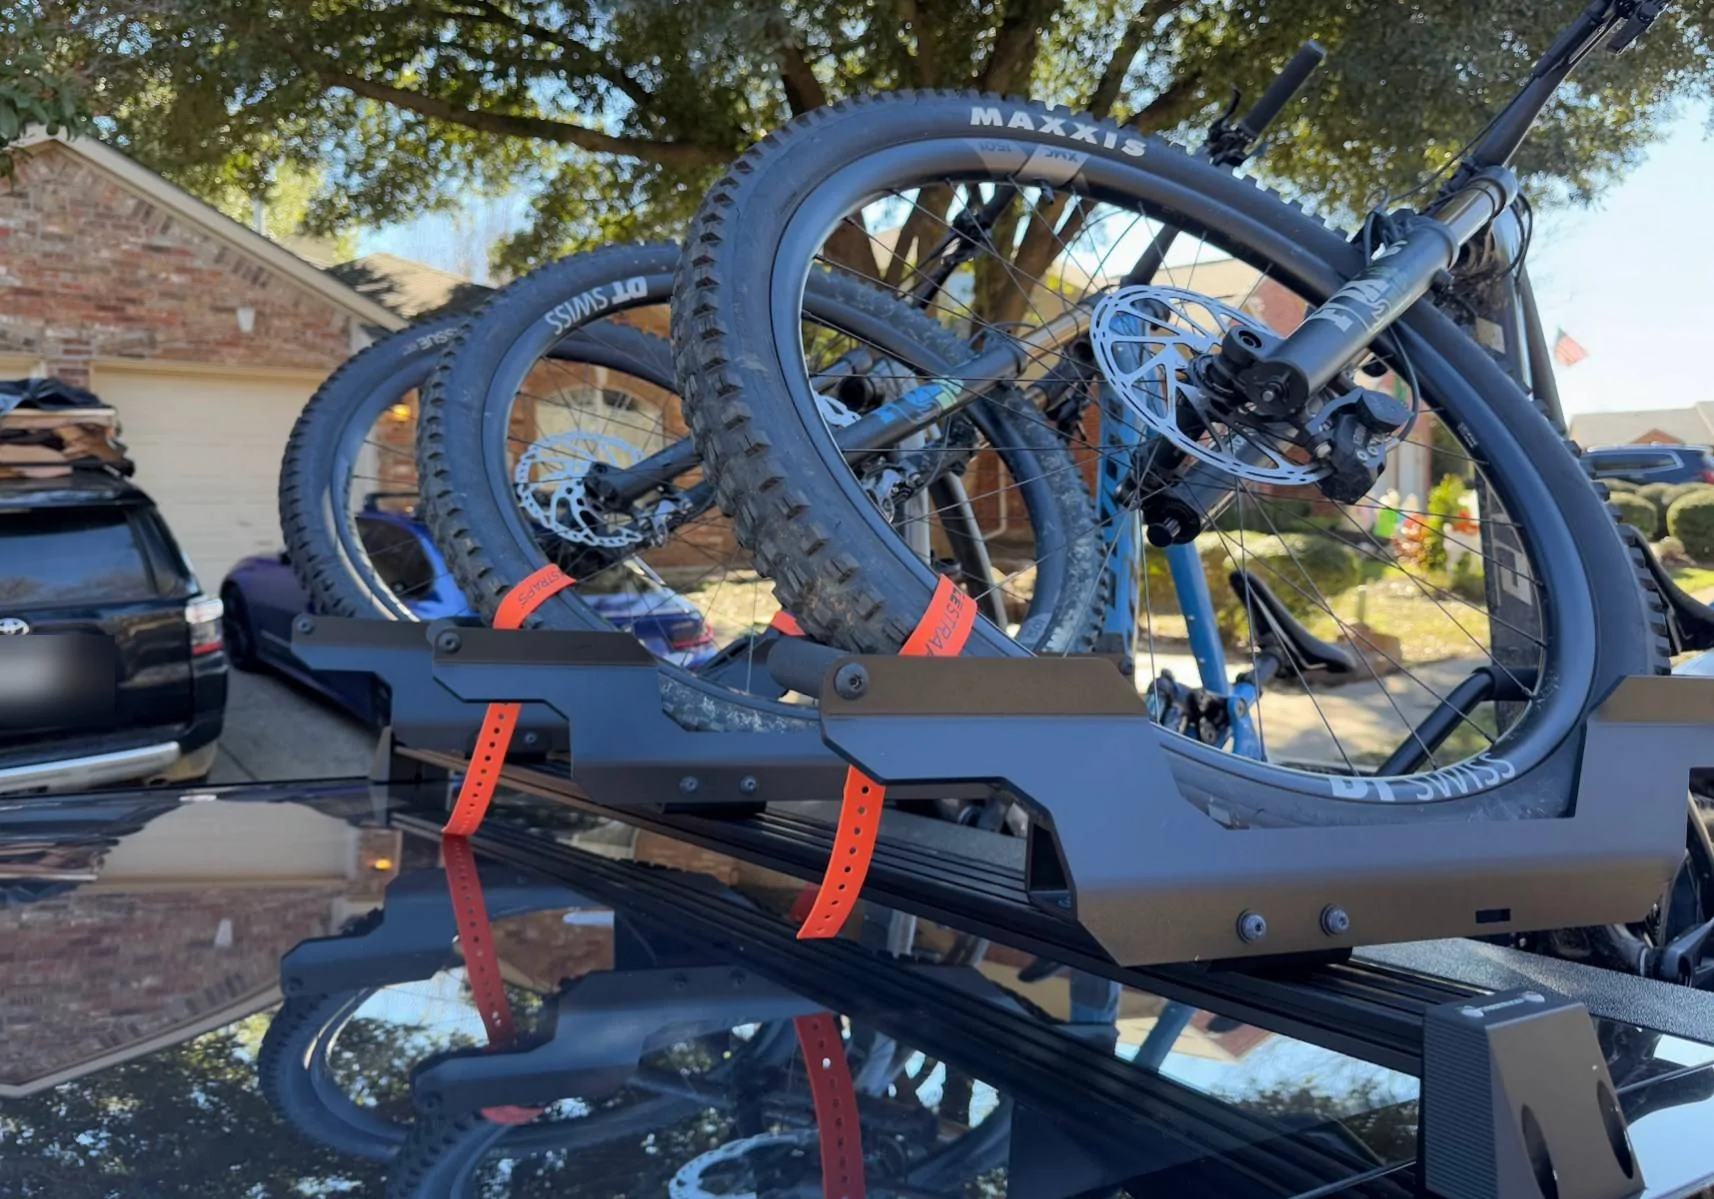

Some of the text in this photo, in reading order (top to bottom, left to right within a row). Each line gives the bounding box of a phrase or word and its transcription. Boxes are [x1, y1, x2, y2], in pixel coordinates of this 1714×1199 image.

[970, 106, 1147, 158] MAXXIS
[544, 276, 649, 336] DT SWISS
[1329, 751, 1516, 803] DT SWISS
